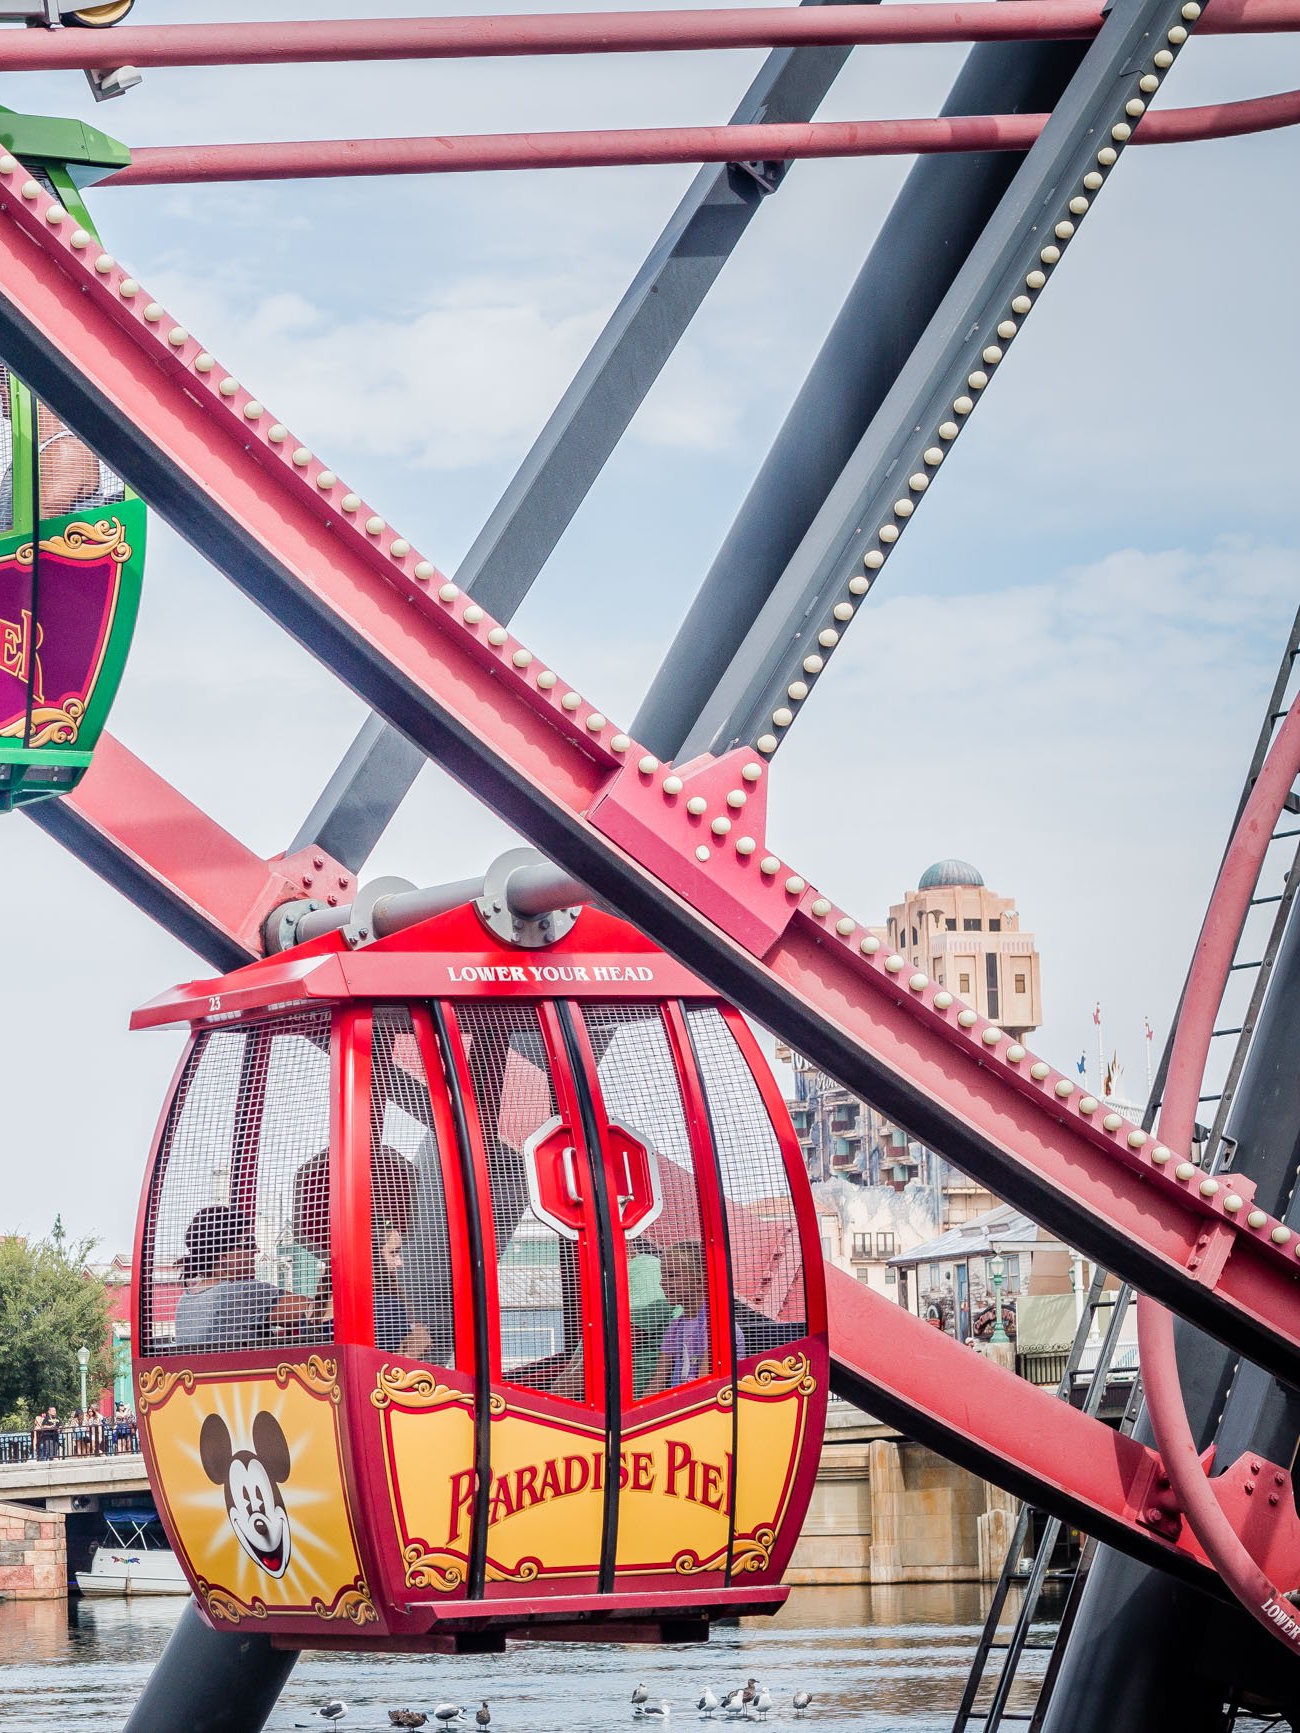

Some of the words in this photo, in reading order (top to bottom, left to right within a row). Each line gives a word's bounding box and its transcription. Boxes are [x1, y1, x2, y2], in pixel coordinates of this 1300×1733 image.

[447, 966, 528, 982] LOWER
[528, 966, 590, 982] YOUR
[592, 966, 654, 982] HEAD
[208, 996, 221, 1012] 23
[1261, 1598, 1300, 1640] LOWER
